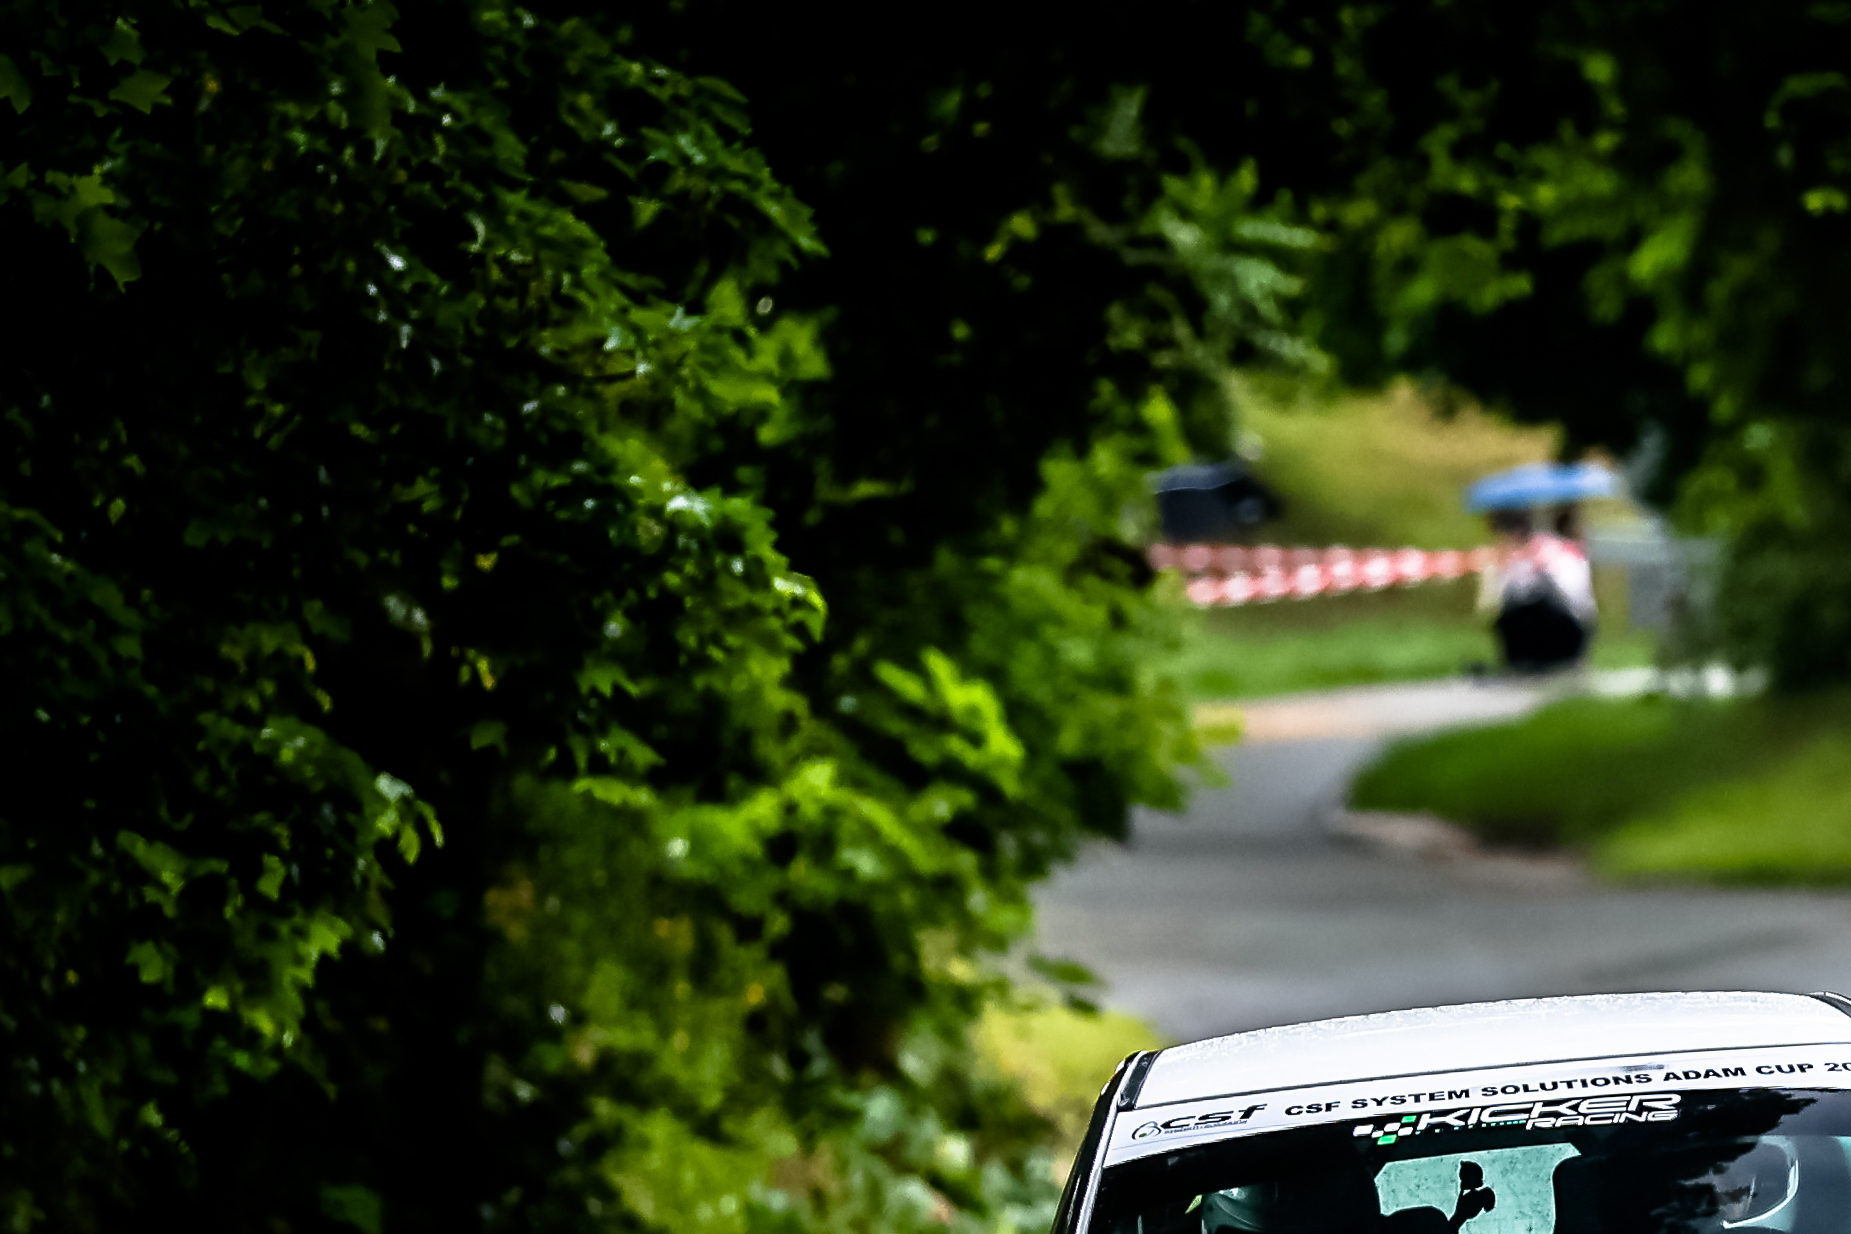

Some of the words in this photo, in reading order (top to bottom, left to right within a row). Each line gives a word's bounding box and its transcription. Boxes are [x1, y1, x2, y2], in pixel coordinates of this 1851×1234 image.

[1284, 1100, 1341, 1116] CSF
[1351, 1088, 1470, 1109] SYSTEM
[1481, 1073, 1653, 1097] SOLUTIONS
[1663, 1066, 1747, 1082] ADAM
[1755, 1063, 1814, 1075] CUP
[1416, 1093, 1682, 1131] KICKER
[1526, 1109, 1681, 1131] RACING
